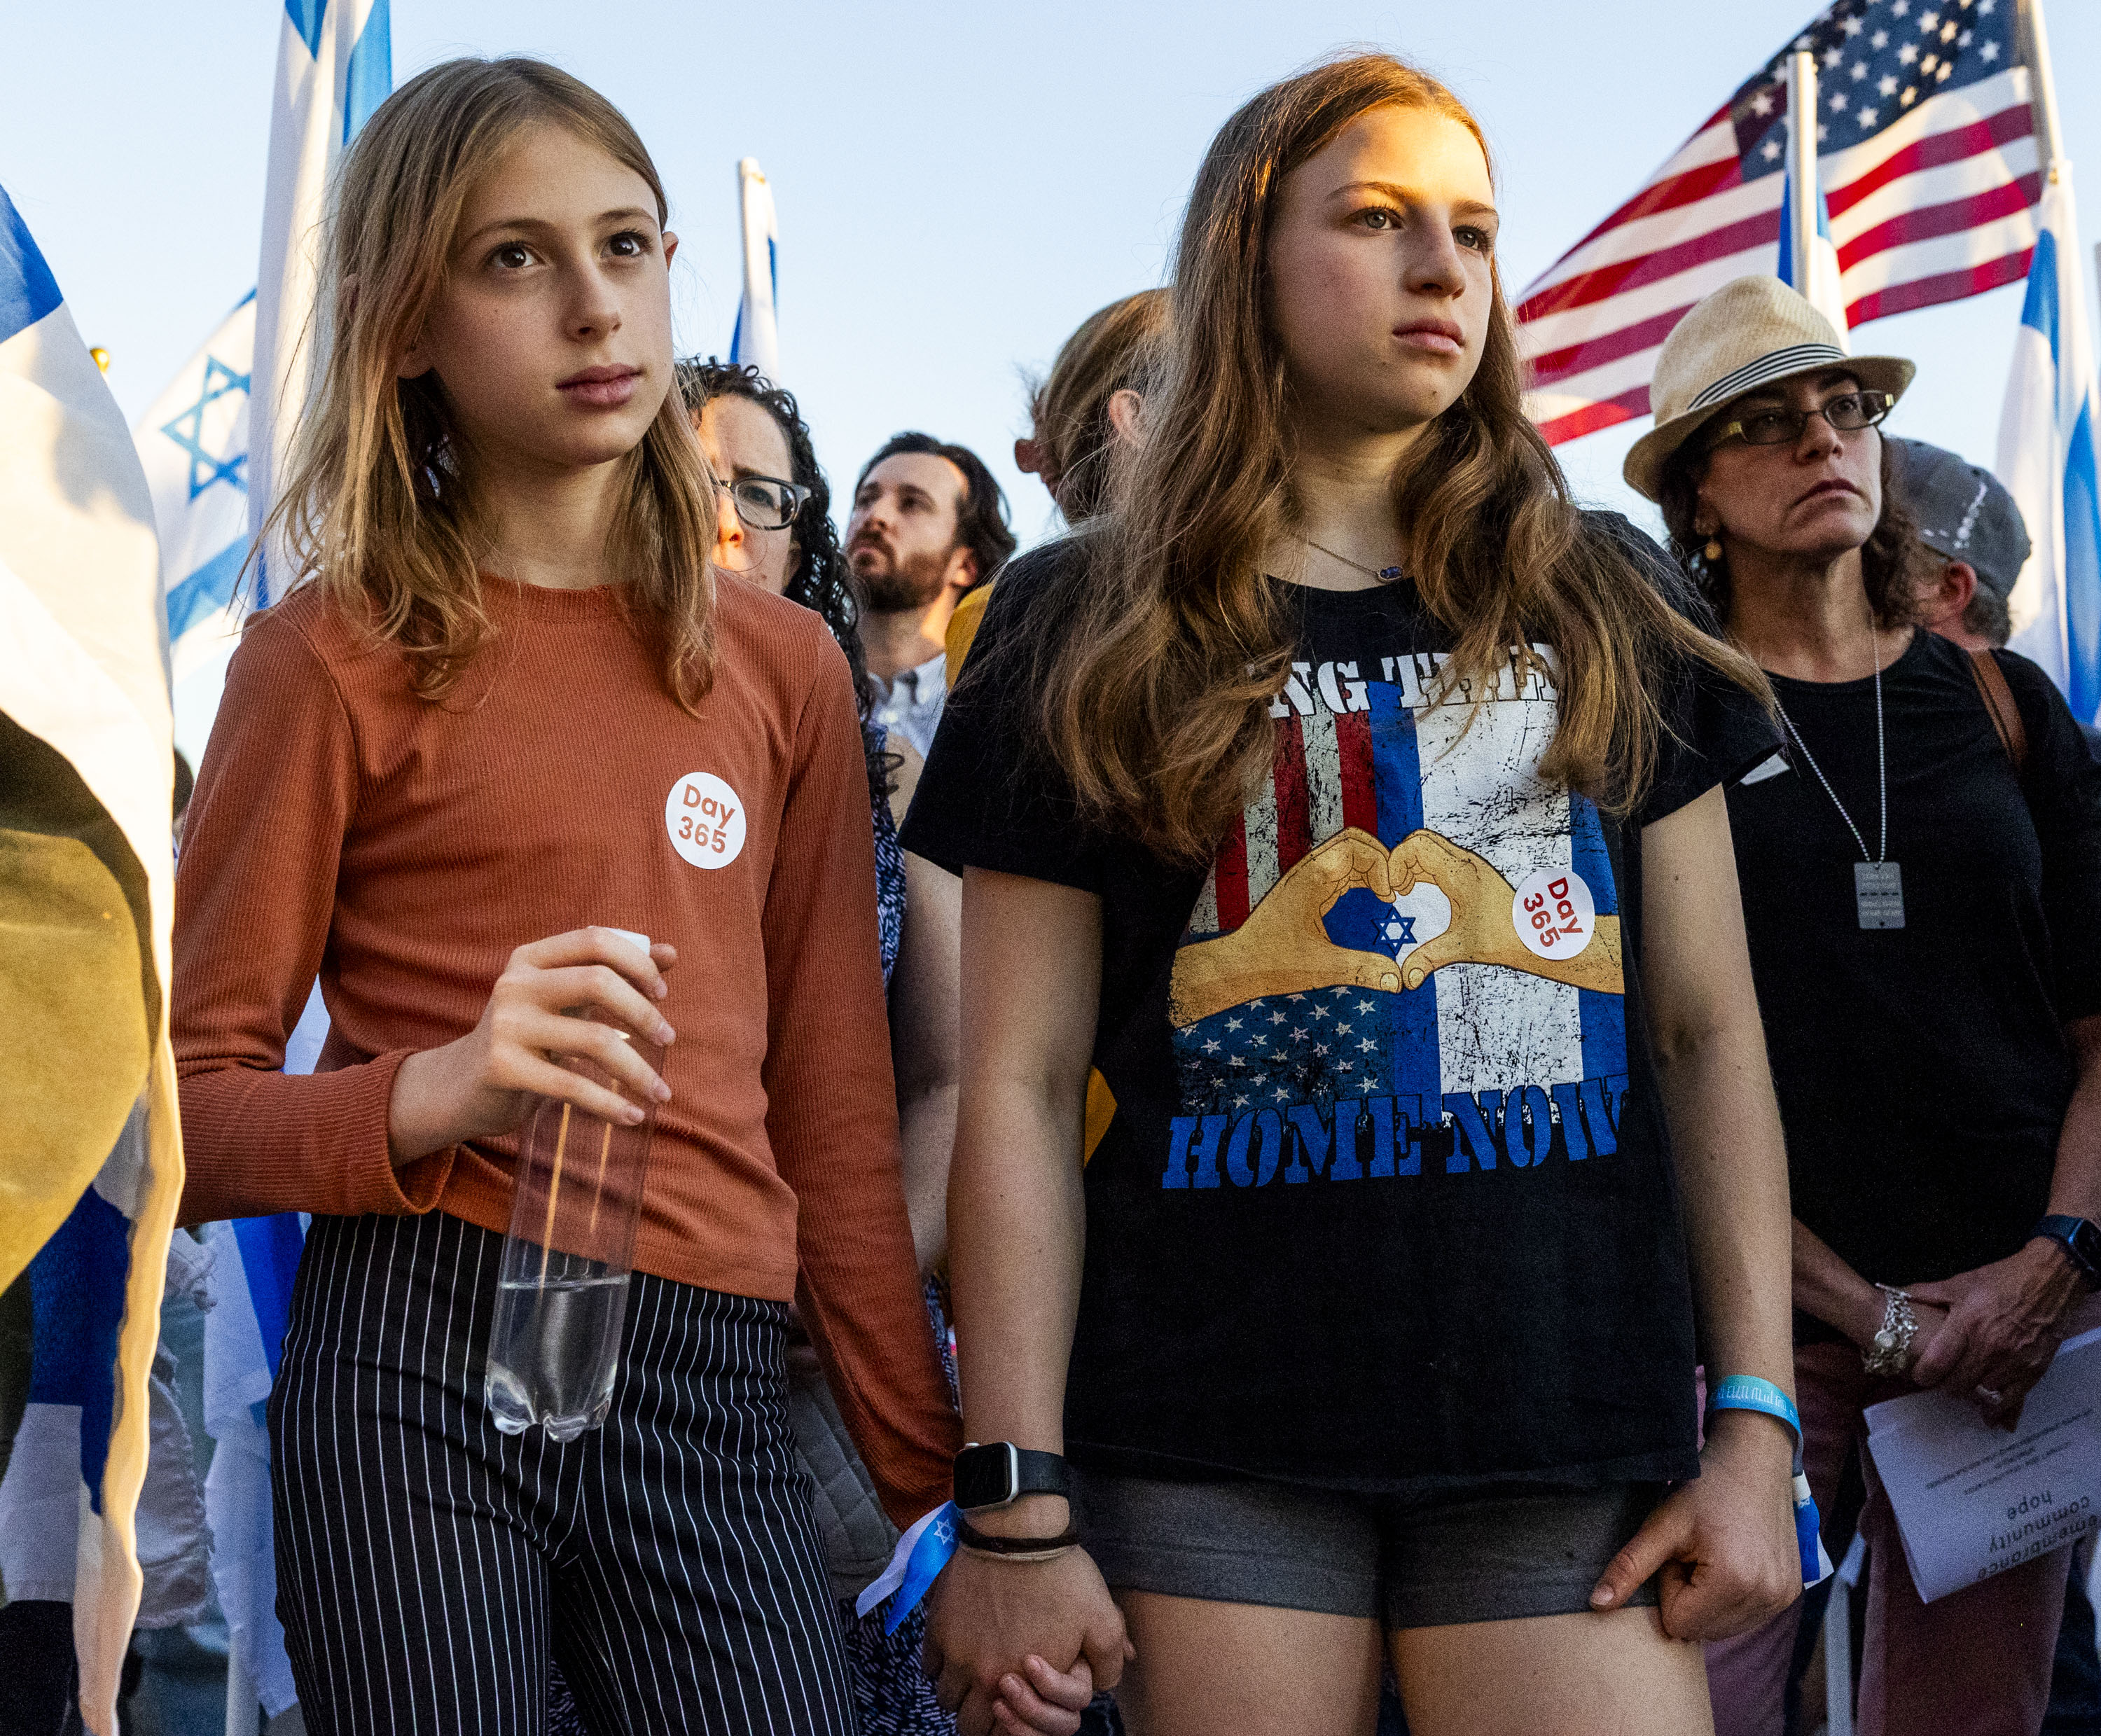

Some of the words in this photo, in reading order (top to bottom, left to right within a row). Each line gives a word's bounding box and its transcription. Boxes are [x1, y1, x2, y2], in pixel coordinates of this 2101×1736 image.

[683, 784, 735, 829] Day
[679, 816, 726, 854] 365
[1524, 893, 1561, 947] 365
[1548, 877, 1583, 933] Day
[1162, 1094, 1422, 1188] HOME
[1443, 1074, 1629, 1174] NOW
[1990, 1496, 2090, 1553] community
[2007, 1490, 2052, 1520] hope
[1977, 1515, 2098, 1578] emembrance
